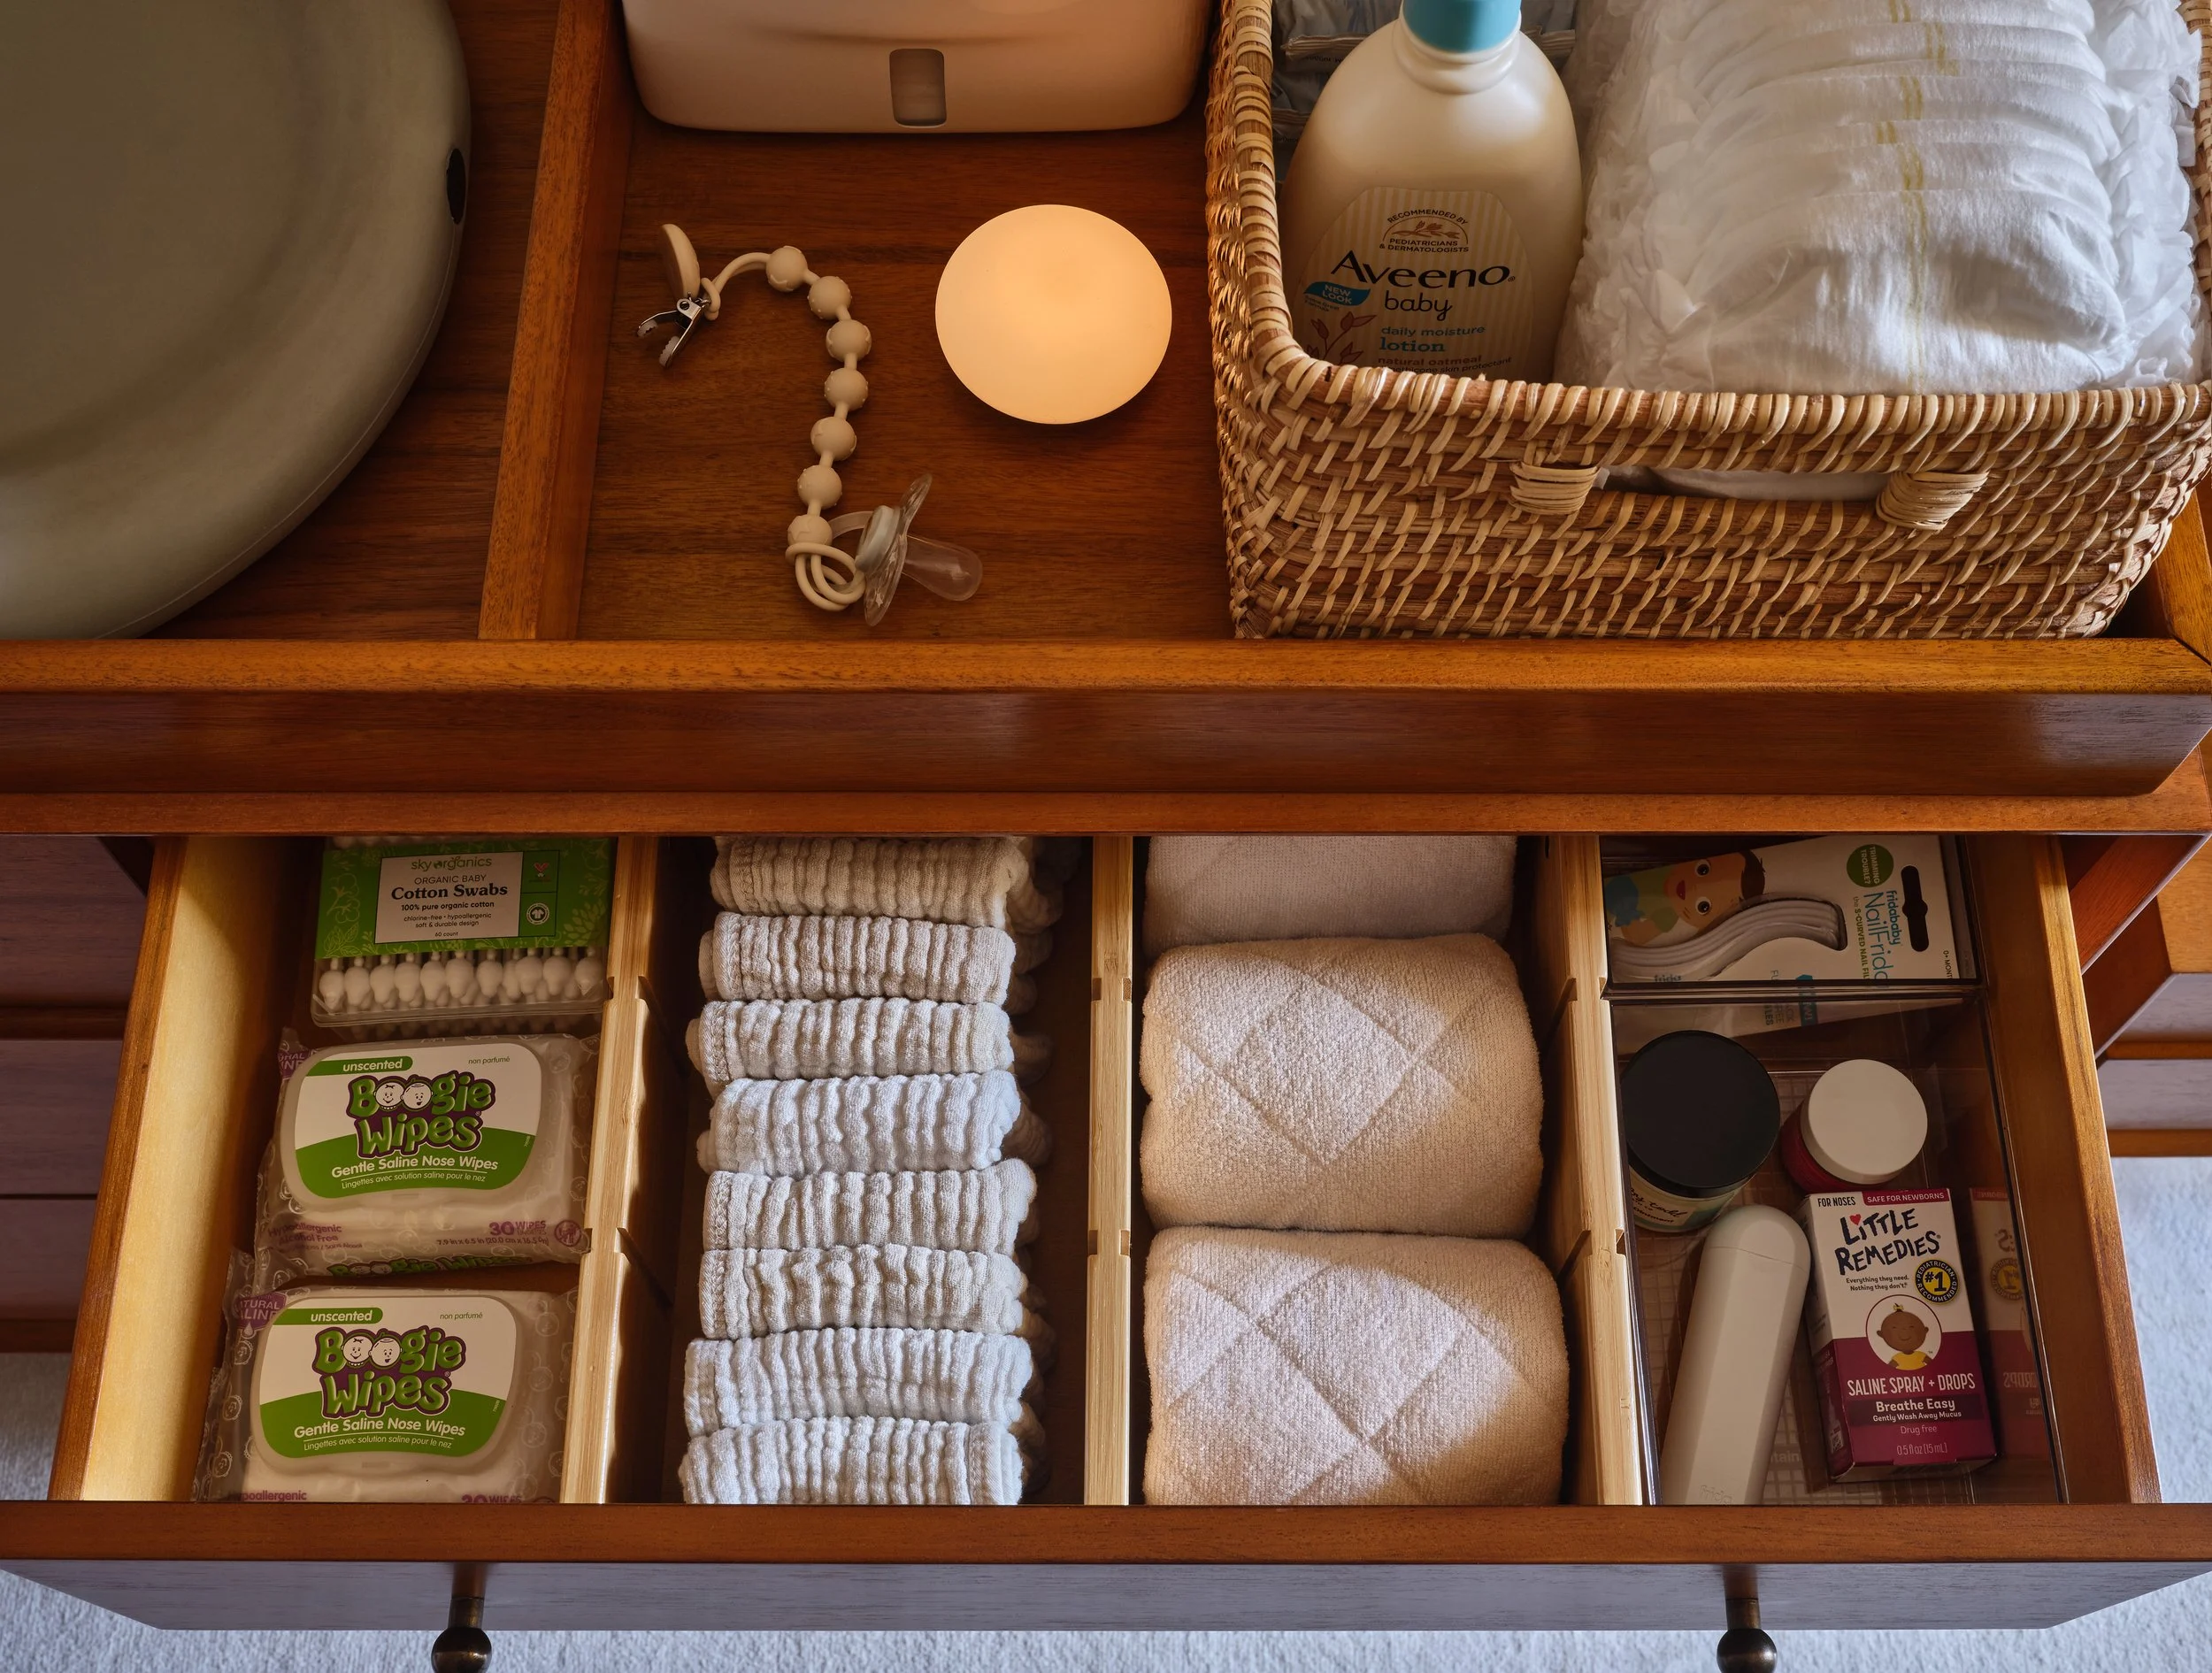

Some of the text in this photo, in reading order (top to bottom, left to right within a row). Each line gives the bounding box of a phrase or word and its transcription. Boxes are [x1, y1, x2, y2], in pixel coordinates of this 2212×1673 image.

[1386, 210, 1469, 226] RECOMMENDED BY
[1387, 244, 1470, 253] DERMATOLOGISTS
[1331, 249, 1510, 288] Aveeno
[1322, 289, 1353, 305] LOOK
[1325, 284, 1352, 296] NEW
[1384, 289, 1453, 321] baby
[1381, 326, 1486, 338] daily moisture
[1379, 337, 1446, 352] lotion
[1378, 356, 1482, 366] natural oatmeal
[1461, 357, 1512, 372] protectant
[1861, 848, 1870, 885] TROUBLE?
[1870, 846, 1881, 885] TRIMMING
[415, 874, 488, 885] ORGANIC BABY
[391, 883, 508, 901] Cotton Swabs
[440, 902, 469, 910] organic
[1887, 889, 1902, 946] fridababy
[1855, 909, 1865, 947] S-CURVED
[1862, 966, 1870, 979] FIL
[342, 1059, 403, 1072] unscented
[483, 1055, 511, 1065] parfumé
[349, 1072, 495, 1117] Boogie
[357, 1113, 481, 1156] Wipes
[332, 1155, 499, 1178] Gentle Saline Nose Wipes
[342, 1178, 374, 1189] Lingettes
[447, 1173, 463, 1182] pour
[1817, 1196, 1856, 1208] FOR NOSES
[1867, 1194, 1885, 1203] SAFE
[1902, 1193, 1945, 1201] NEWBORNS
[268, 1222, 342, 1237] Hypoallergenic
[488, 1221, 547, 1236] 30 WIPES
[1916, 1261, 1955, 1279] PEDIATRICIAN
[1846, 1276, 1878, 1285] Everything
[1925, 1271, 1947, 1293] #1
[1917, 1281, 1958, 1302] RECOMMENDED
[310, 1310, 373, 1323] unscented
[455, 1311, 483, 1322] parfumé
[313, 1327, 465, 1374] Boogie
[1847, 1378, 1888, 1397] SALINE
[1890, 1375, 1925, 1395] SPRAY
[1938, 1373, 1976, 1392] DROPS
[323, 1370, 450, 1417] Wipes
[1876, 1398, 1955, 1412] Breathe Easy
[1873, 1414, 1895, 1423] Gently
[1918, 1411, 1938, 1420] Away
[294, 1417, 465, 1439] Gentle Saline Nose Wipes
[1901, 1424, 1938, 1436] Drug free
[303, 1439, 337, 1452] Lingettes
[339, 1437, 357, 1446] avec
[357, 1435, 387, 1445] solution
[388, 1435, 411, 1444] saline
[411, 1437, 429, 1447] pour
[439, 1440, 452, 1449] nez
